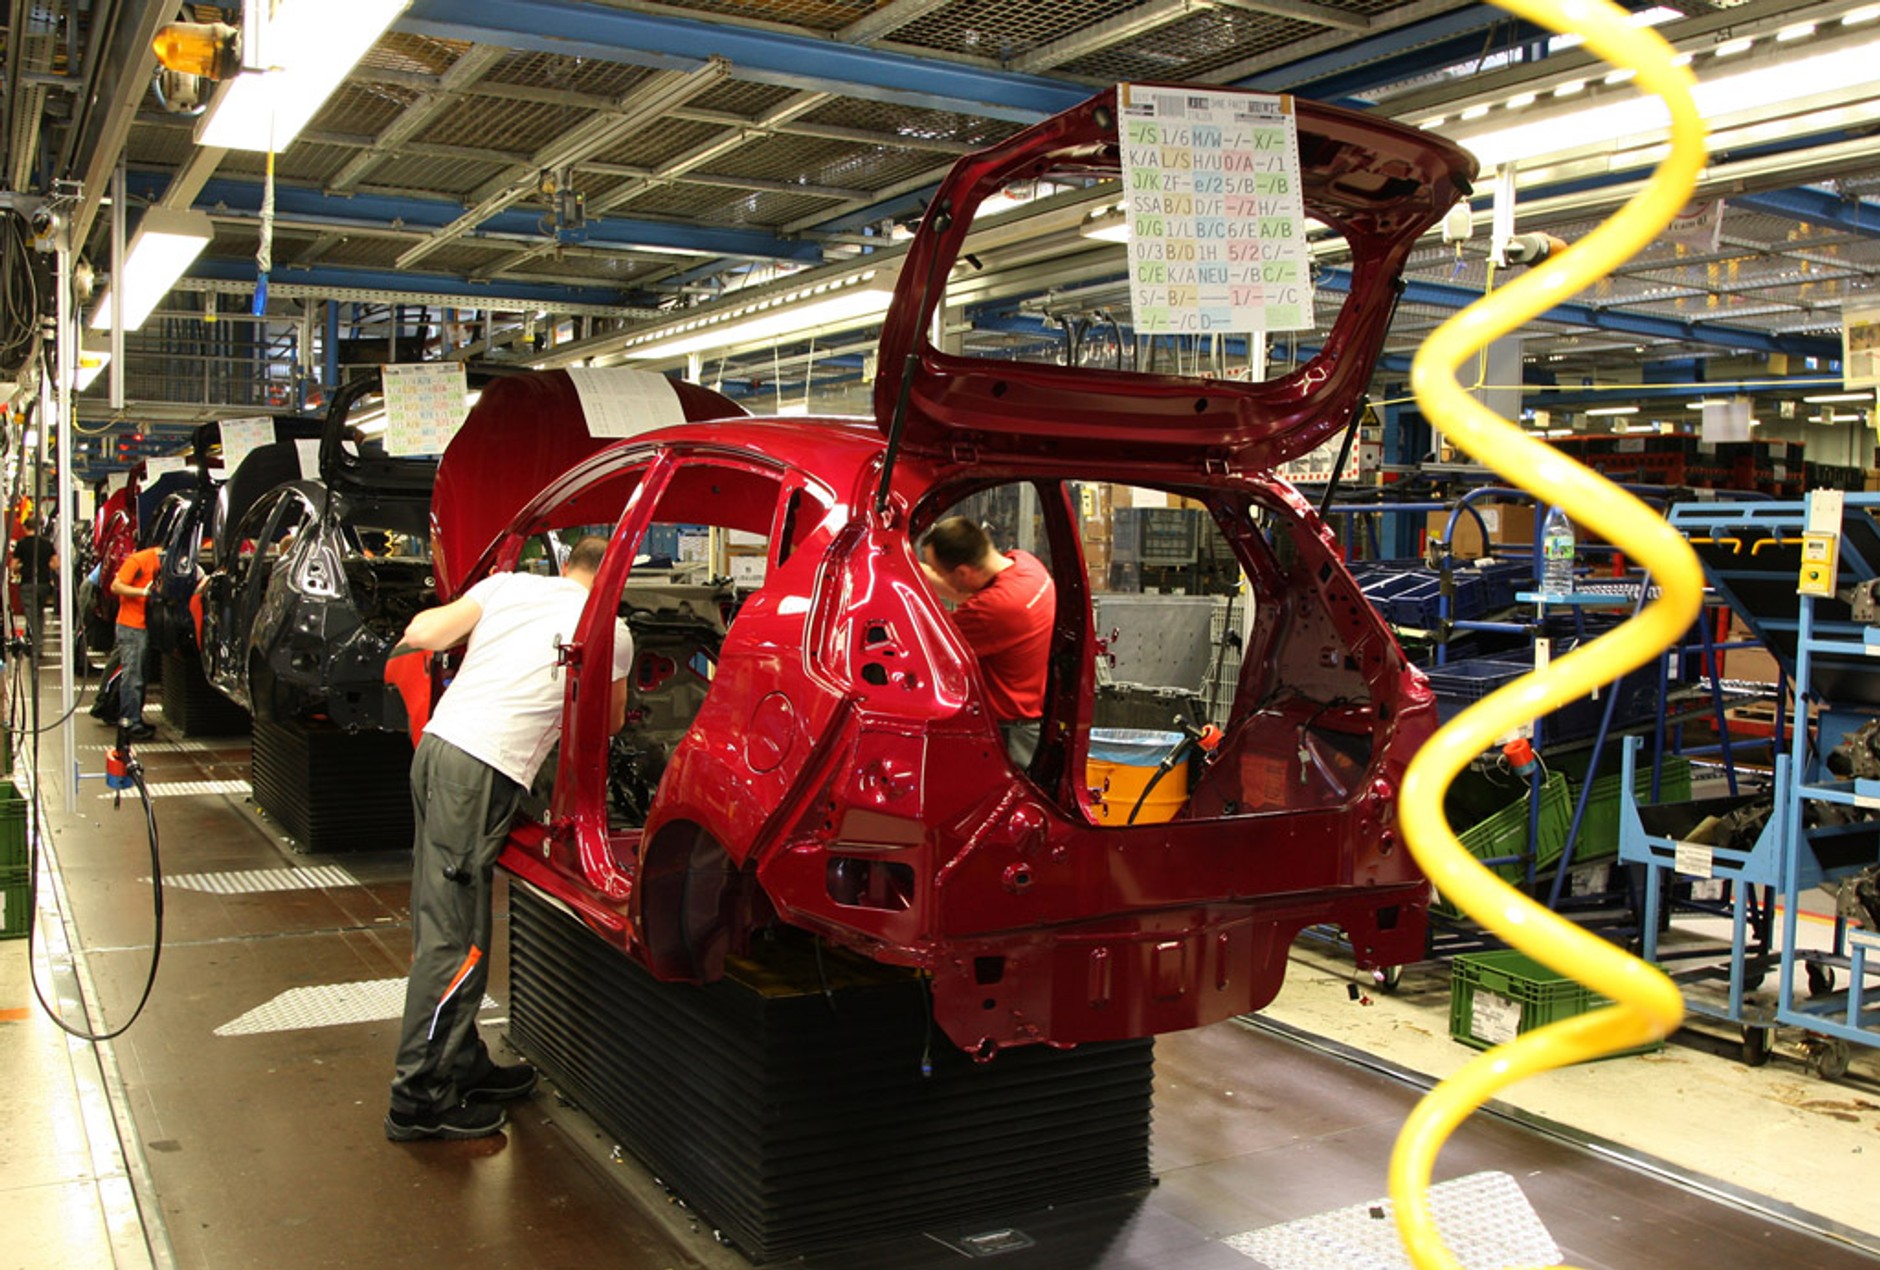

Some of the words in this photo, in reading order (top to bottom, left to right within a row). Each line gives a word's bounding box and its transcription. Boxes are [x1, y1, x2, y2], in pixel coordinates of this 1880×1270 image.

[1161, 128, 1189, 146] 1/6
[1129, 150, 1158, 167] K/A
[1162, 152, 1190, 169] L/S
[1193, 154, 1222, 170] H/U
[1132, 172, 1160, 190] J/K
[1225, 178, 1255, 194] 5/B
[1134, 196, 1162, 213] SSA
[1164, 198, 1192, 215] B/J
[1166, 221, 1193, 238] 1/L
[1197, 222, 1225, 238] B/C
[1228, 222, 1257, 238] 6/E
[1260, 222, 1292, 238] A/B
[1199, 245, 1217, 261] 1H
[1228, 245, 1259, 261] 5/2
[1138, 266, 1164, 283] C/E
[1168, 267, 1196, 283] K/A
[1198, 268, 1228, 284] NEU
[1264, 266, 1296, 283] C/-
